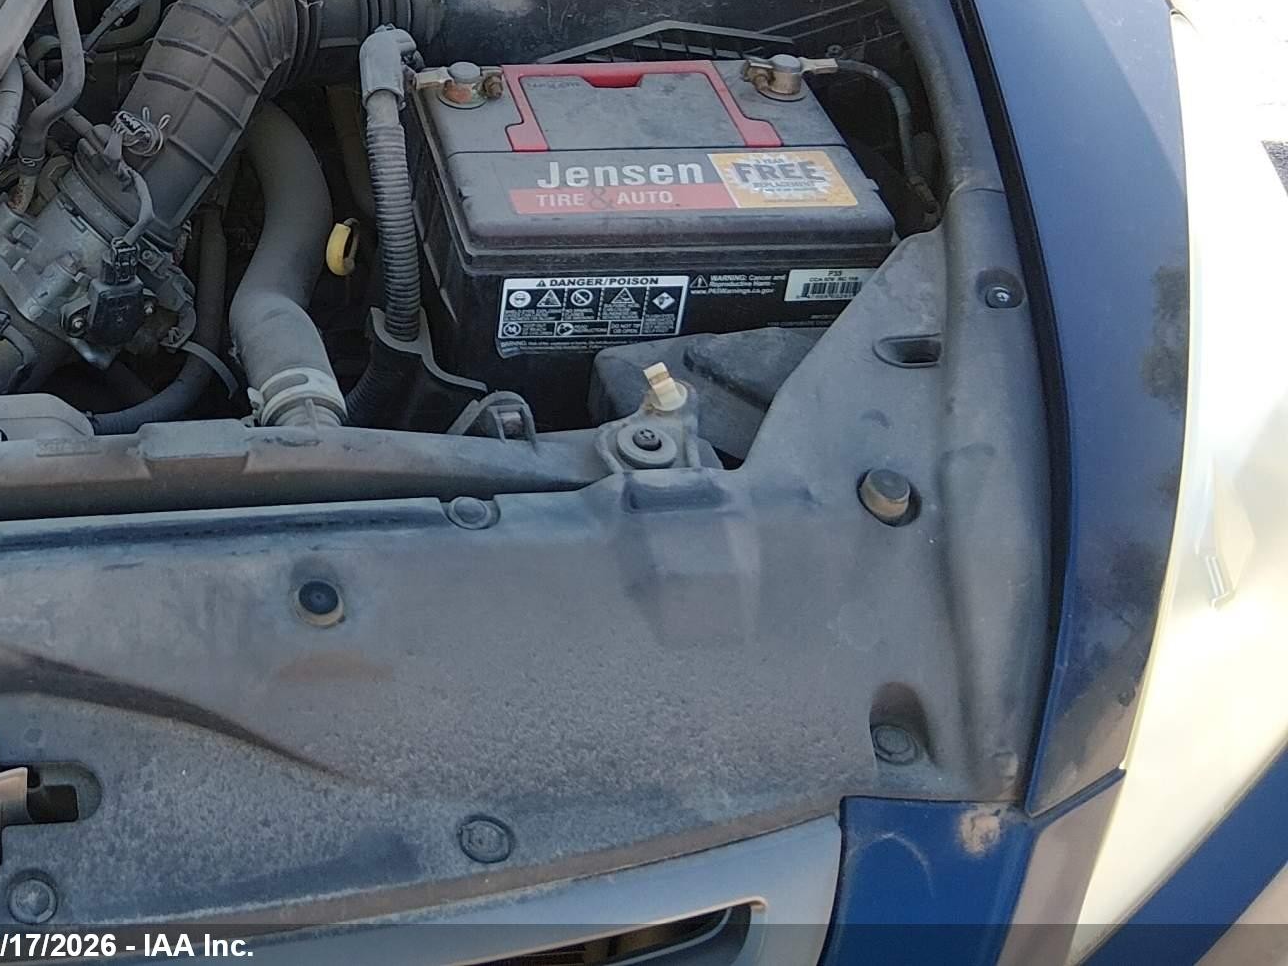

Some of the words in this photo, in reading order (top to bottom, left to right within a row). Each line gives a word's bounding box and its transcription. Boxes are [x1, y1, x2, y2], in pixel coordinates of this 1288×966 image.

[537, 160, 704, 188] Jensen
[731, 160, 827, 183] FREE
[535, 192, 585, 207] TIRE
[589, 186, 610, 211] &
[616, 190, 673, 205] AUTO
[549, 277, 659, 287] DANGER/POISON
